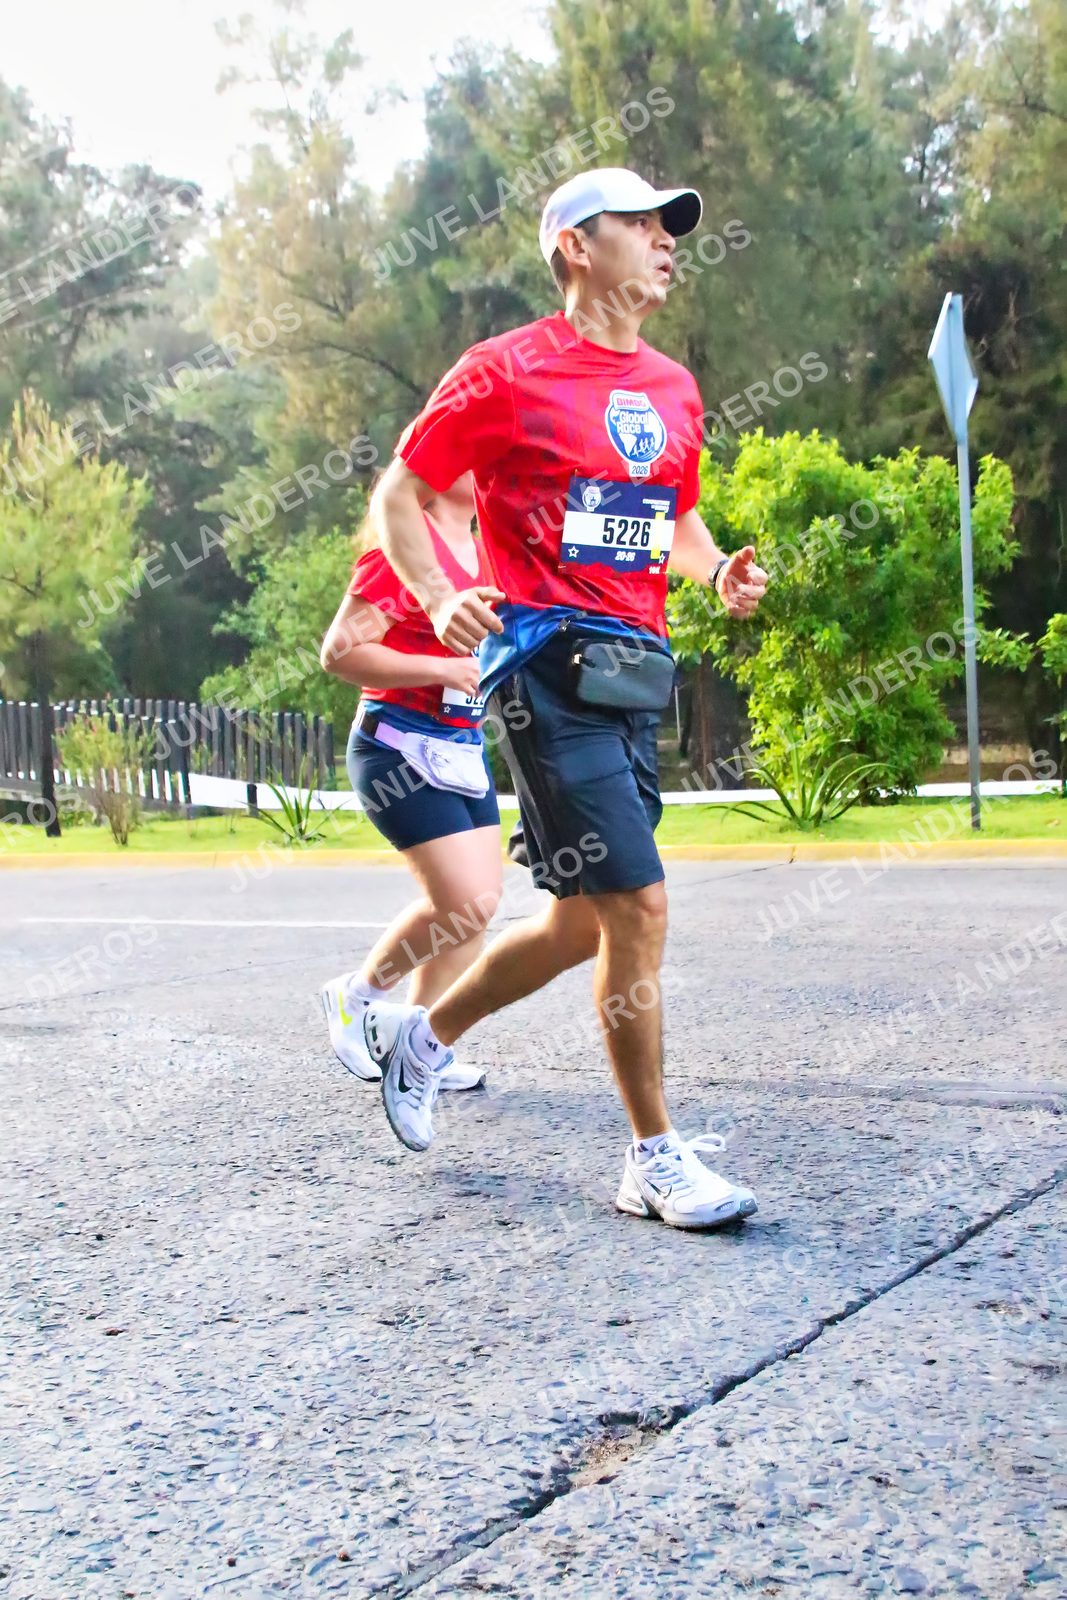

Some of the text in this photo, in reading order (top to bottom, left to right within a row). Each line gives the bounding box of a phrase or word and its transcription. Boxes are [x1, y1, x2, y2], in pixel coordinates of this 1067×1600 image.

[619, 411, 649, 424] Global
[617, 422, 641, 434] Race
[632, 466, 648, 475] 2026
[602, 517, 651, 547] 5226
